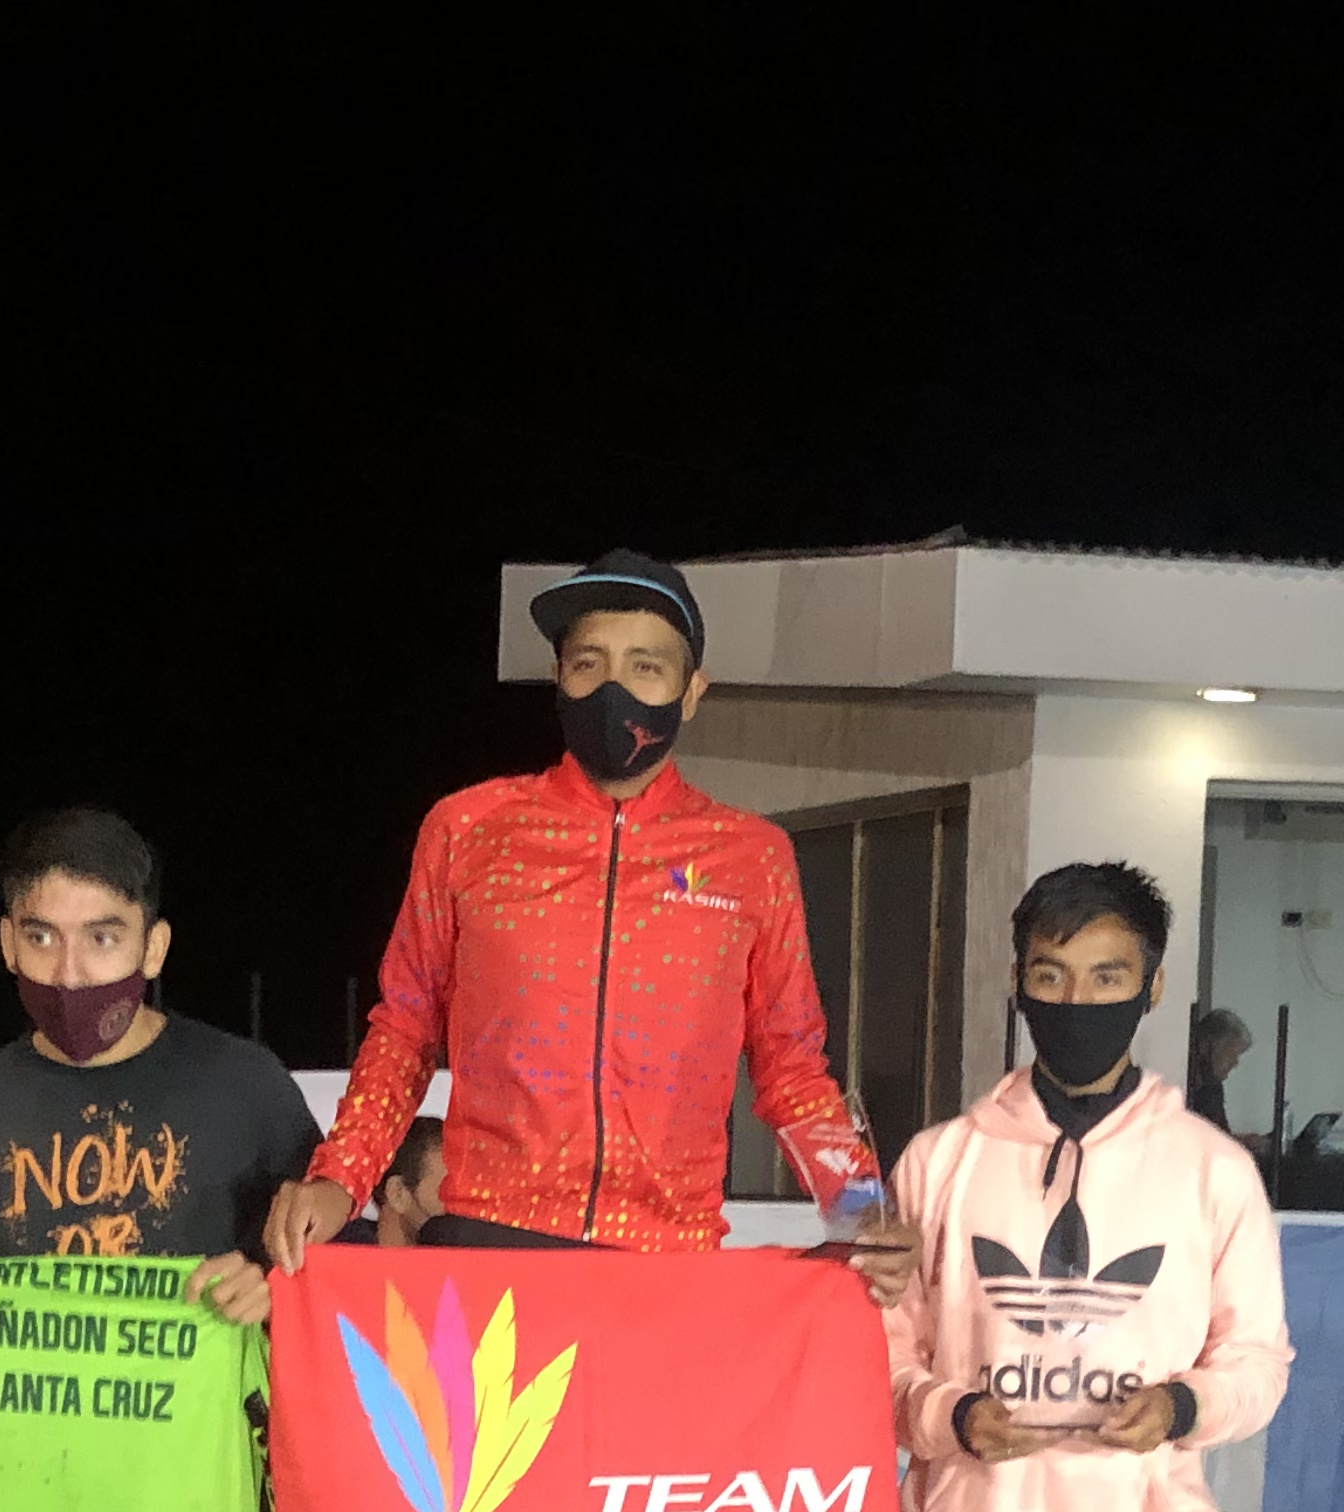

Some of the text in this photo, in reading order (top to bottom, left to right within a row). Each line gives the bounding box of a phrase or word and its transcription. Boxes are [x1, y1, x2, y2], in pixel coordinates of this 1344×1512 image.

[8, 1123, 178, 1217] NOW
[116, 1319, 198, 1361] SECO
[92, 1377, 175, 1423] CRUZ
